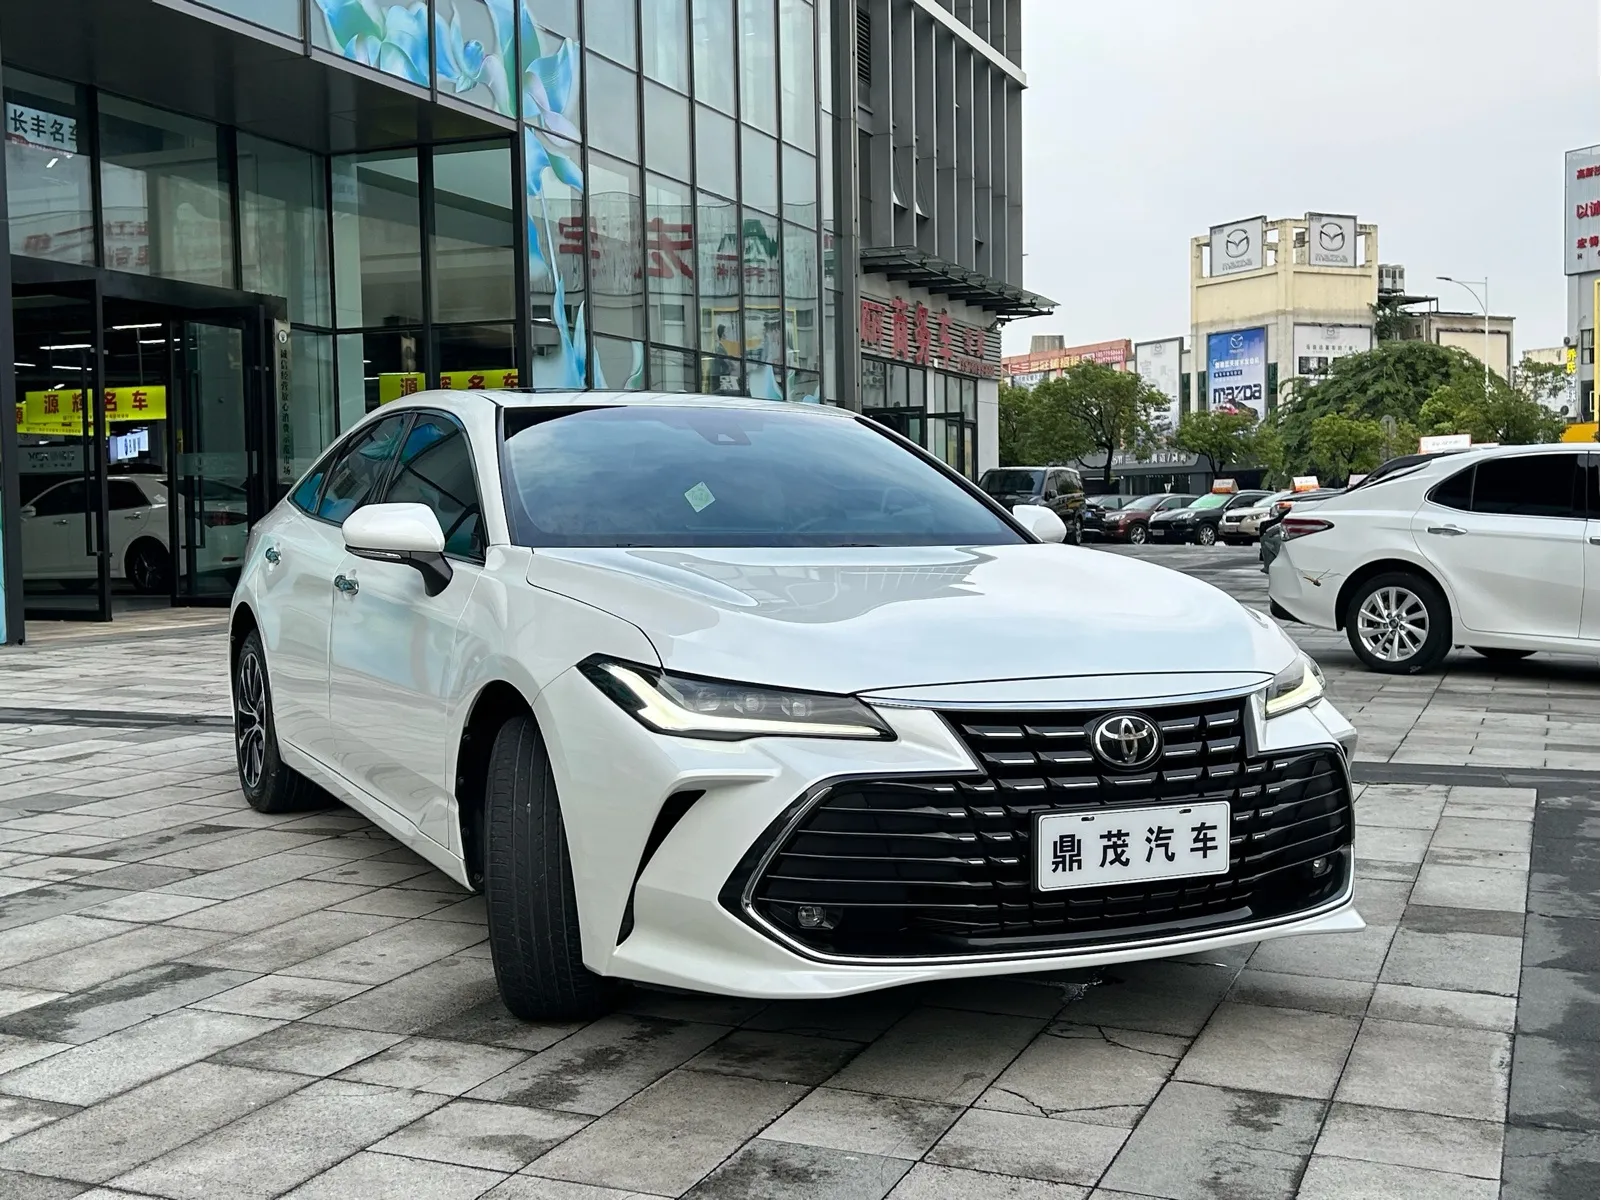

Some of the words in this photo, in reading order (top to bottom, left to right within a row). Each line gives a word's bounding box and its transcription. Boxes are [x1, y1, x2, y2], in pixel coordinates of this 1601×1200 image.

[1213, 383, 1262, 404] mazda
[1051, 822, 1218, 873] 鼎茂汽车
